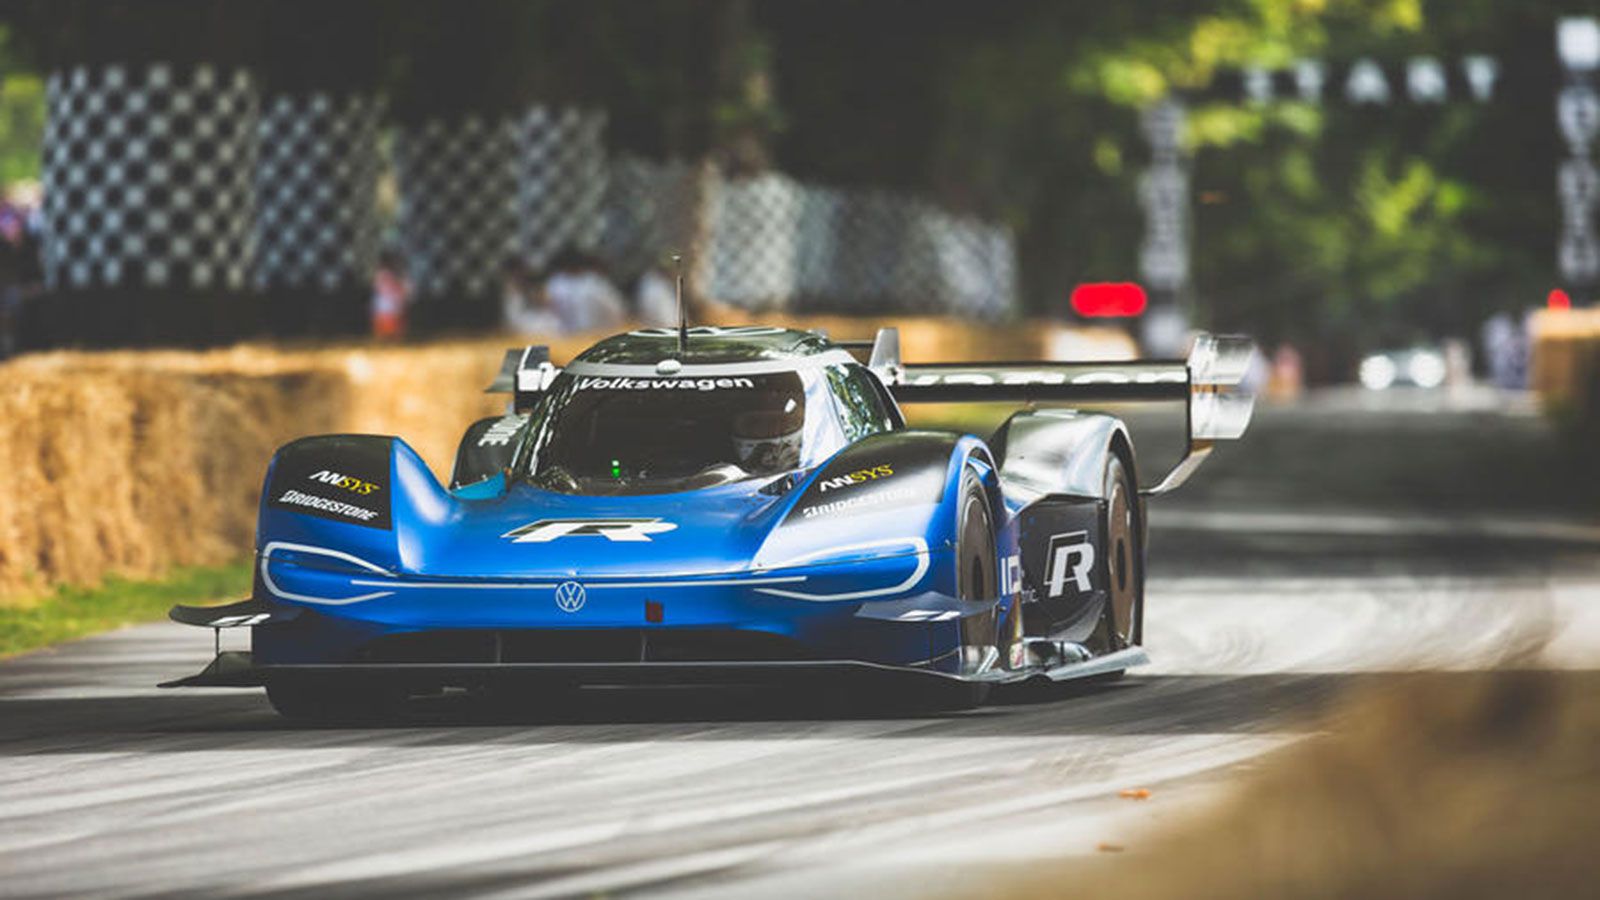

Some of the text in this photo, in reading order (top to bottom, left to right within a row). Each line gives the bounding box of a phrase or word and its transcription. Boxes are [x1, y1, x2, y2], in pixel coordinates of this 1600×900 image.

[580, 377, 754, 391] Volkswagen
[308, 470, 380, 495] ANSYS
[820, 463, 894, 492] ANSYS
[279, 489, 378, 520] BRIDGESTONE
[1044, 530, 1096, 598] R
